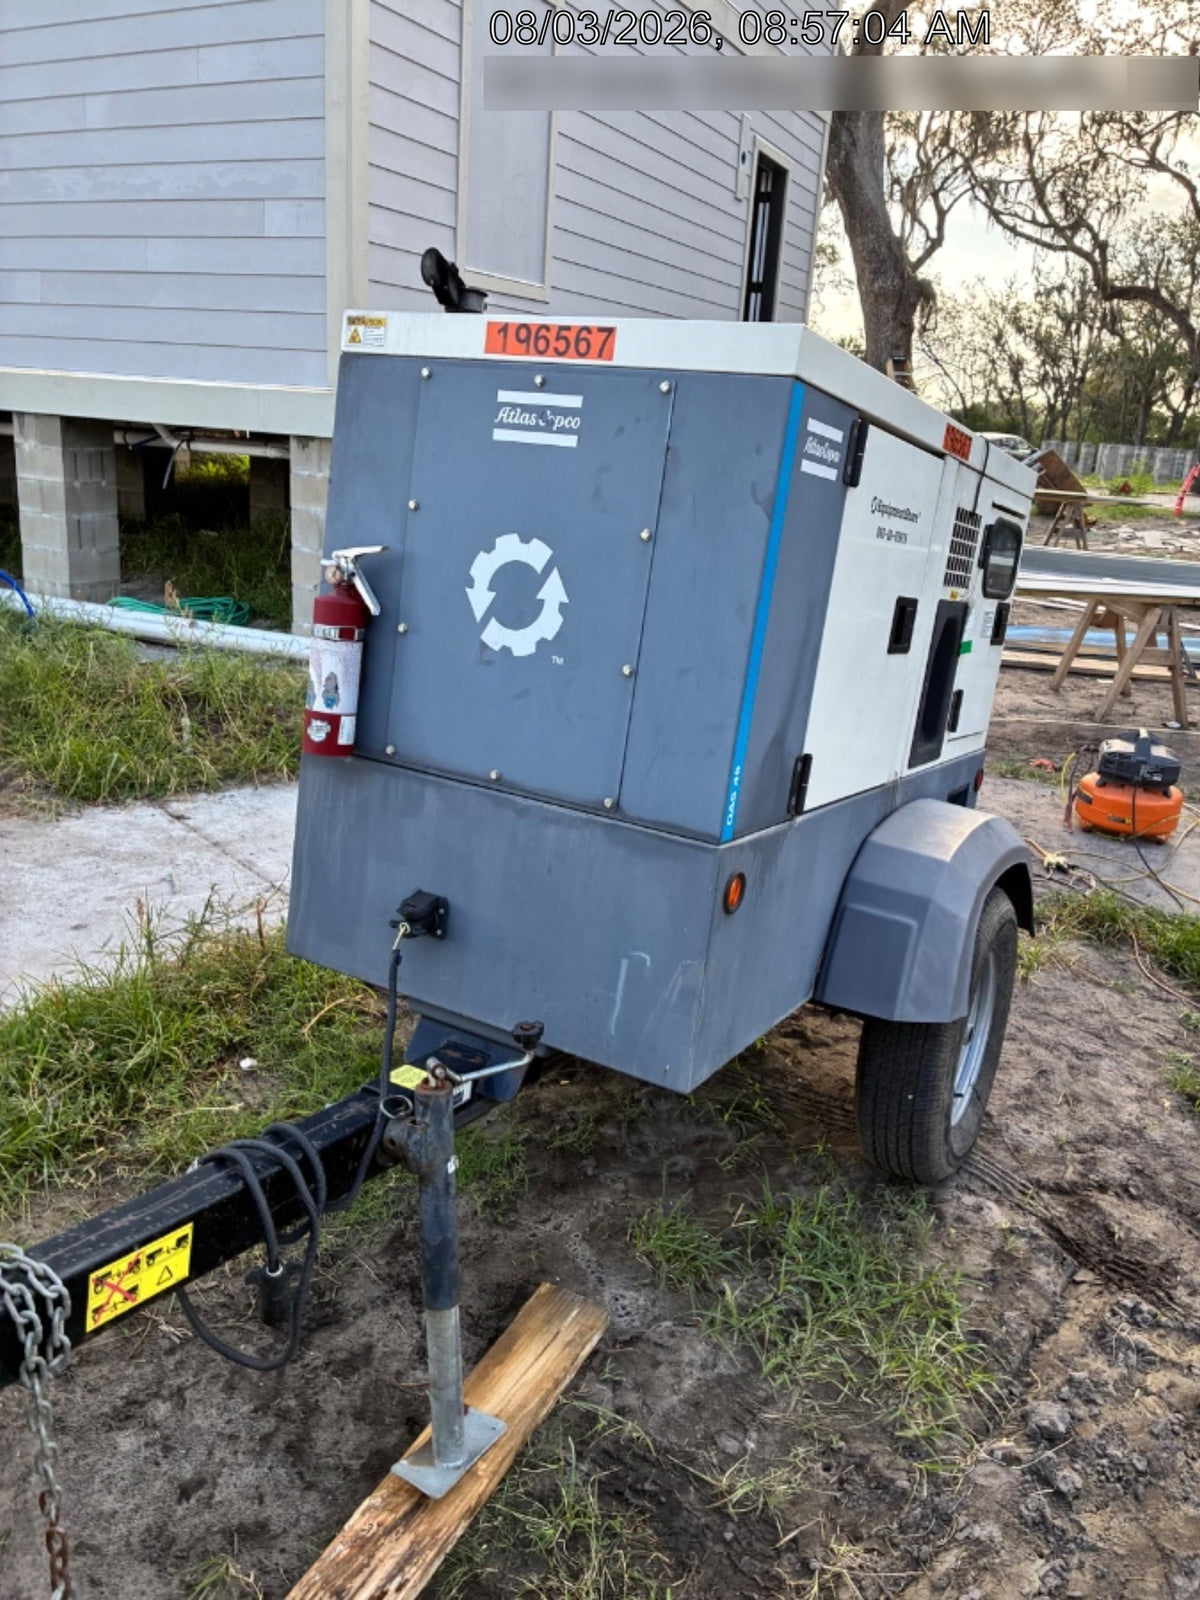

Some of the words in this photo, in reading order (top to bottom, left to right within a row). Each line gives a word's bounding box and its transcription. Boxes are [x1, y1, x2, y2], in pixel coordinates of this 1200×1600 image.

[496, 323, 615, 359] 196567
[494, 406, 538, 426] Atlas
[538, 410, 581, 431] pco
